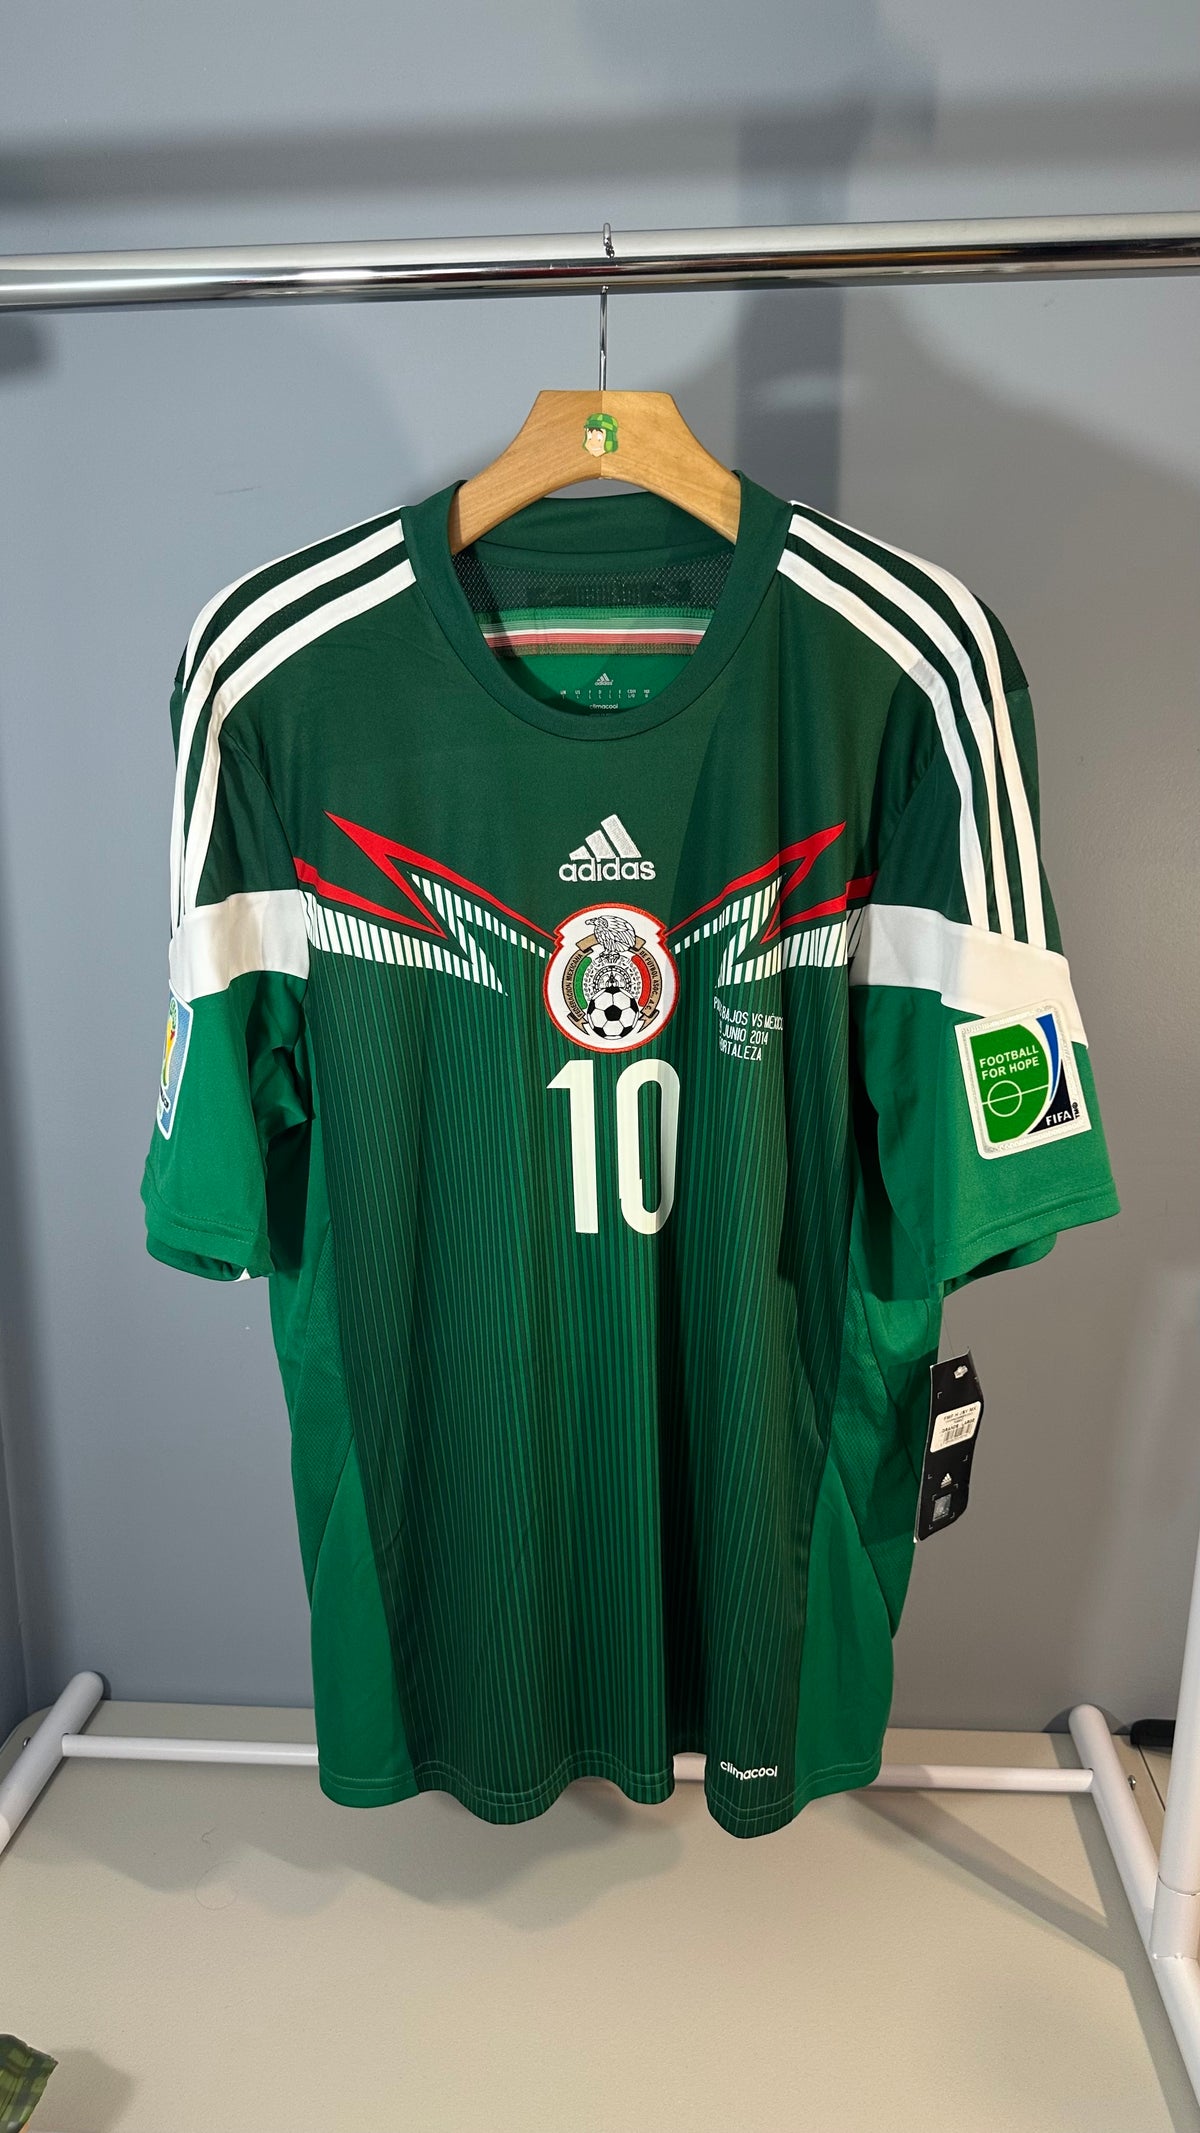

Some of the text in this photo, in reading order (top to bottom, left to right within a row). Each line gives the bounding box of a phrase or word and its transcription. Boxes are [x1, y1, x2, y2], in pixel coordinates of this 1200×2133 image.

[559, 857, 656, 882] adidas
[565, 953, 583, 981] MEXICANA
[645, 957, 658, 978] FUTBOL
[752, 1012, 764, 1028] VS
[722, 1024, 747, 1042] JUNIO
[749, 1030, 769, 1045] 2014
[719, 1036, 762, 1061] ORTALEZA
[979, 1045, 1040, 1069] FOOTBALL
[981, 1056, 1040, 1081] FOR HOPE
[1045, 1110, 1072, 1126] FIFA
[546, 1058, 681, 1235] 10
[720, 1760, 778, 1781] climacool
